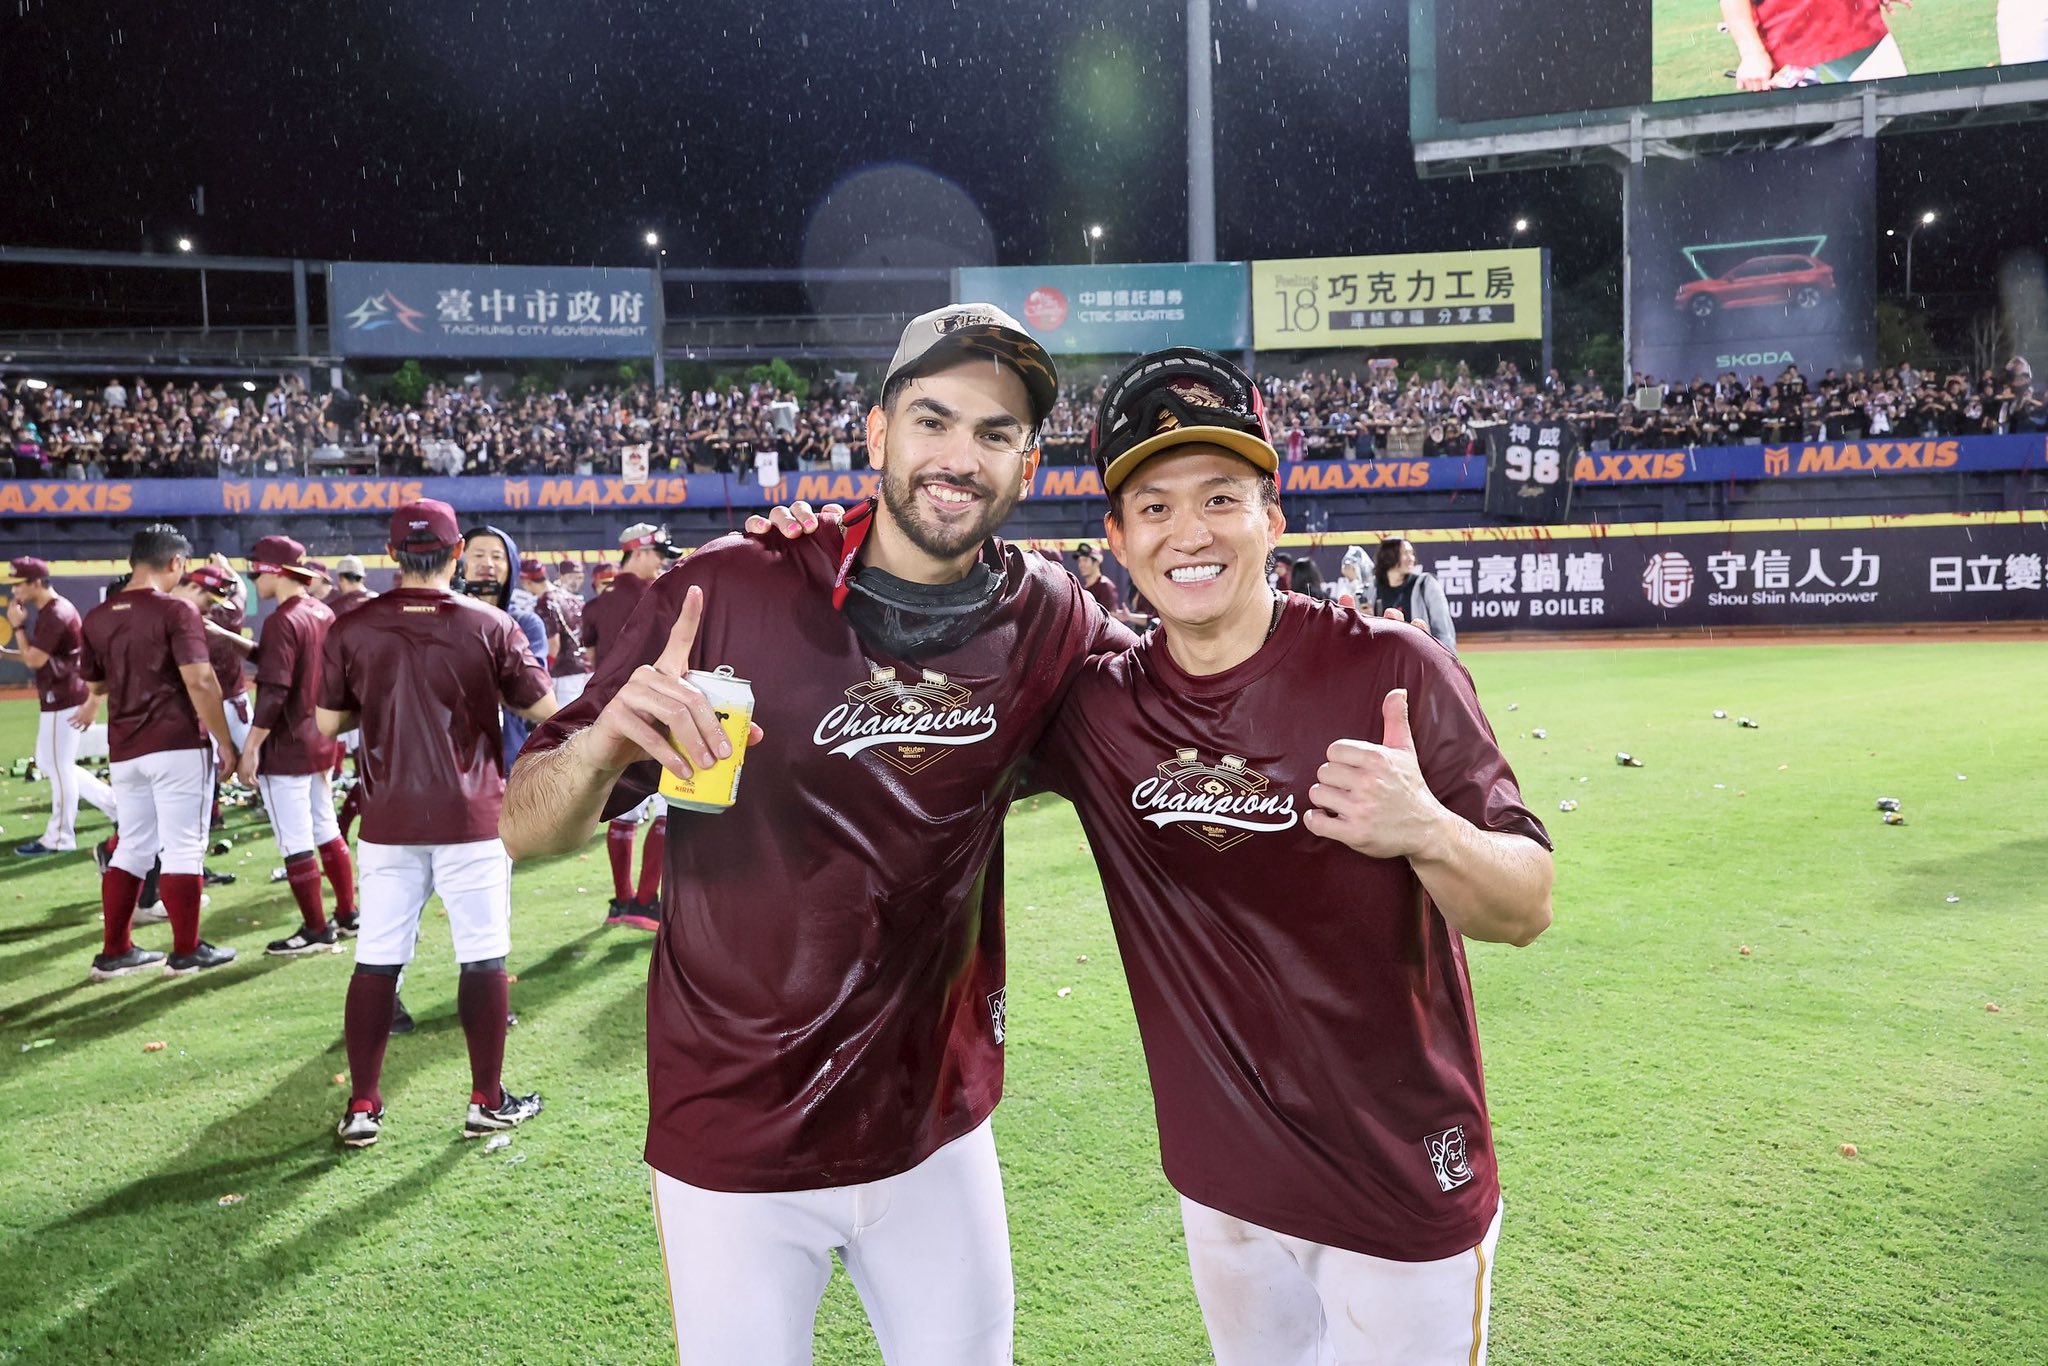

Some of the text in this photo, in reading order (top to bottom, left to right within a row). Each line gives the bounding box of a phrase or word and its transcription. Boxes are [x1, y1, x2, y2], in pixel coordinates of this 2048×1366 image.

[1328, 266, 1515, 305] 巧克力工房
[436, 288, 645, 324] 臺中市政府
[1079, 308, 1185, 323] CTBC SECURITIES
[1276, 288, 1320, 332] 18
[441, 323, 648, 337] TAICHUNG CITY GOVERNMENT
[1504, 445, 1561, 484] 98
[1573, 452, 1687, 482] AXXIS
[1796, 440, 1960, 473] MAXXIS
[794, 474, 883, 501] MAX
[1285, 461, 1431, 491] MAXXIS
[0, 482, 134, 513] AXXIS
[259, 480, 424, 510] MAXXIS
[537, 477, 687, 507] MAXXIS
[1434, 552, 1605, 596] 志豪鍋爐
[1706, 547, 1881, 591] 守信人力
[1929, 552, 2048, 593] 日立變
[1450, 597, 1605, 618] U HOW BOILER
[1708, 590, 1879, 606] Shou Shin Manpower
[813, 702, 998, 746] Champions
[898, 745, 926, 754] Rakuten
[674, 785, 696, 795] KIRIN
[1131, 777, 1296, 817] Champions
